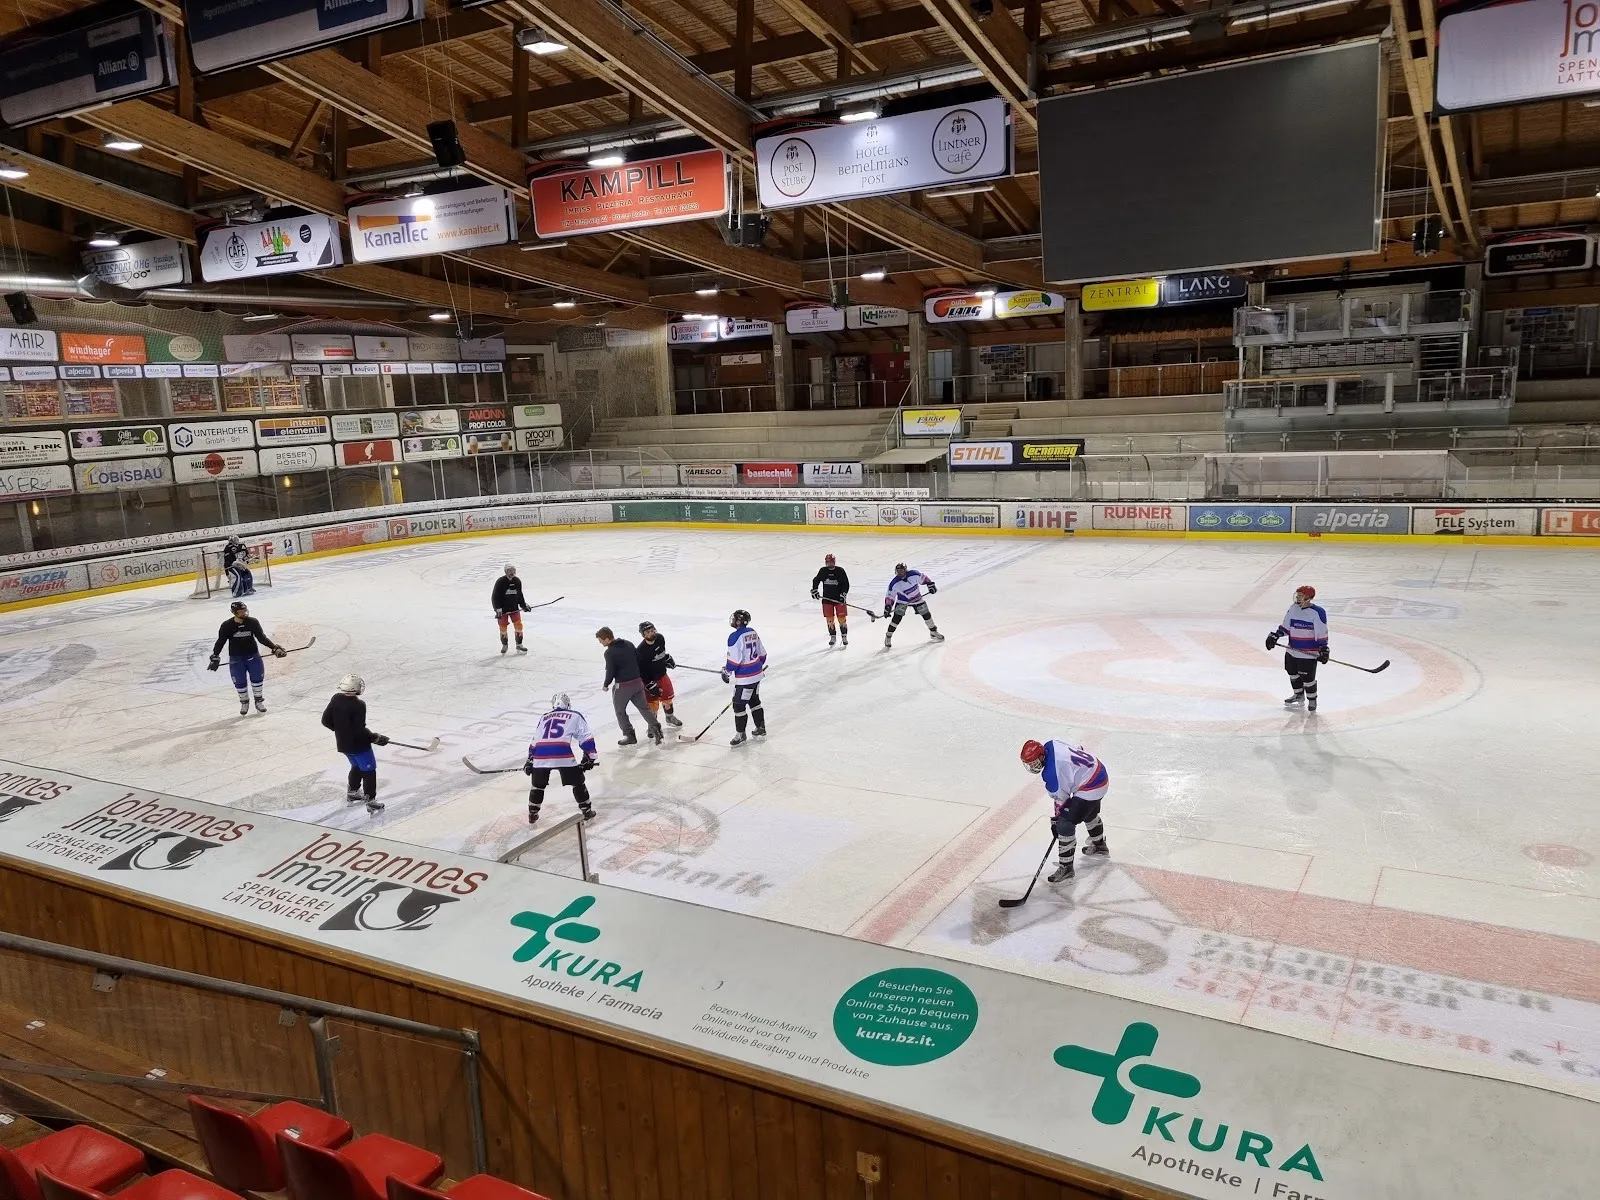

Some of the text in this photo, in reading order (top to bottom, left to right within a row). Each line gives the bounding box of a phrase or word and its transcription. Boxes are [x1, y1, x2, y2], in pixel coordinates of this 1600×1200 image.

[98, 58, 127, 76] Allianz
[560, 161, 695, 203] KAMPILL
[437, 223, 500, 239] www.kanaltec.it
[1090, 285, 1149, 299] ZENTRAL
[10, 332, 45, 349] MAIR
[68, 345, 111, 357] windhager
[68, 367, 91, 376] alperia
[110, 367, 134, 376] alperia
[469, 408, 505, 420] AMONN
[281, 426, 318, 435] element
[290, 419, 317, 427] intern
[194, 427, 248, 437] UNTERHOFER
[953, 447, 1005, 460] STIHL
[1023, 444, 1079, 458] tecnomag
[747, 469, 792, 478] bautechnik
[813, 465, 852, 475] HELLA
[814, 506, 849, 518] isifer
[1029, 511, 1077, 528] IIHF
[1104, 506, 1172, 519] RUBNER
[1313, 509, 1390, 531] alperia
[411, 518, 457, 532] PLONER
[1146, 520, 1174, 530] türen
[1435, 517, 1515, 530] TELE System
[124, 557, 194, 577] RaikaRitten
[21, 579, 68, 594] logistik
[542, 718, 566, 739] 15
[62, 792, 254, 841] Johannes
[26, 839, 103, 865] LATTONIERE
[41, 831, 118, 856] SPENGLEREI
[256, 833, 489, 895] Johannes
[237, 881, 335, 912] SPENGLEREI
[221, 891, 320, 923] LATTONIERE
[539, 949, 644, 993] KURA
[878, 980, 953, 995] Besuchen Sie
[521, 974, 585, 1002] Apotheke
[597, 993, 663, 1020] Farmacia
[868, 990, 954, 1007] unseren neuen
[846, 998, 970, 1021] Online Shop bequem
[701, 1013, 791, 1043] Online und vor Ort
[709, 1003, 818, 1039] Bozen-Algund-Marling
[852, 1011, 954, 1031] von Zuhause aus.
[856, 1027, 936, 1047] kura.bz.it.
[692, 1023, 870, 1080] Individuelle Beratung und Produkte
[1142, 1106, 1324, 1182] KURA
[1131, 1145, 1242, 1187] Apotheke
